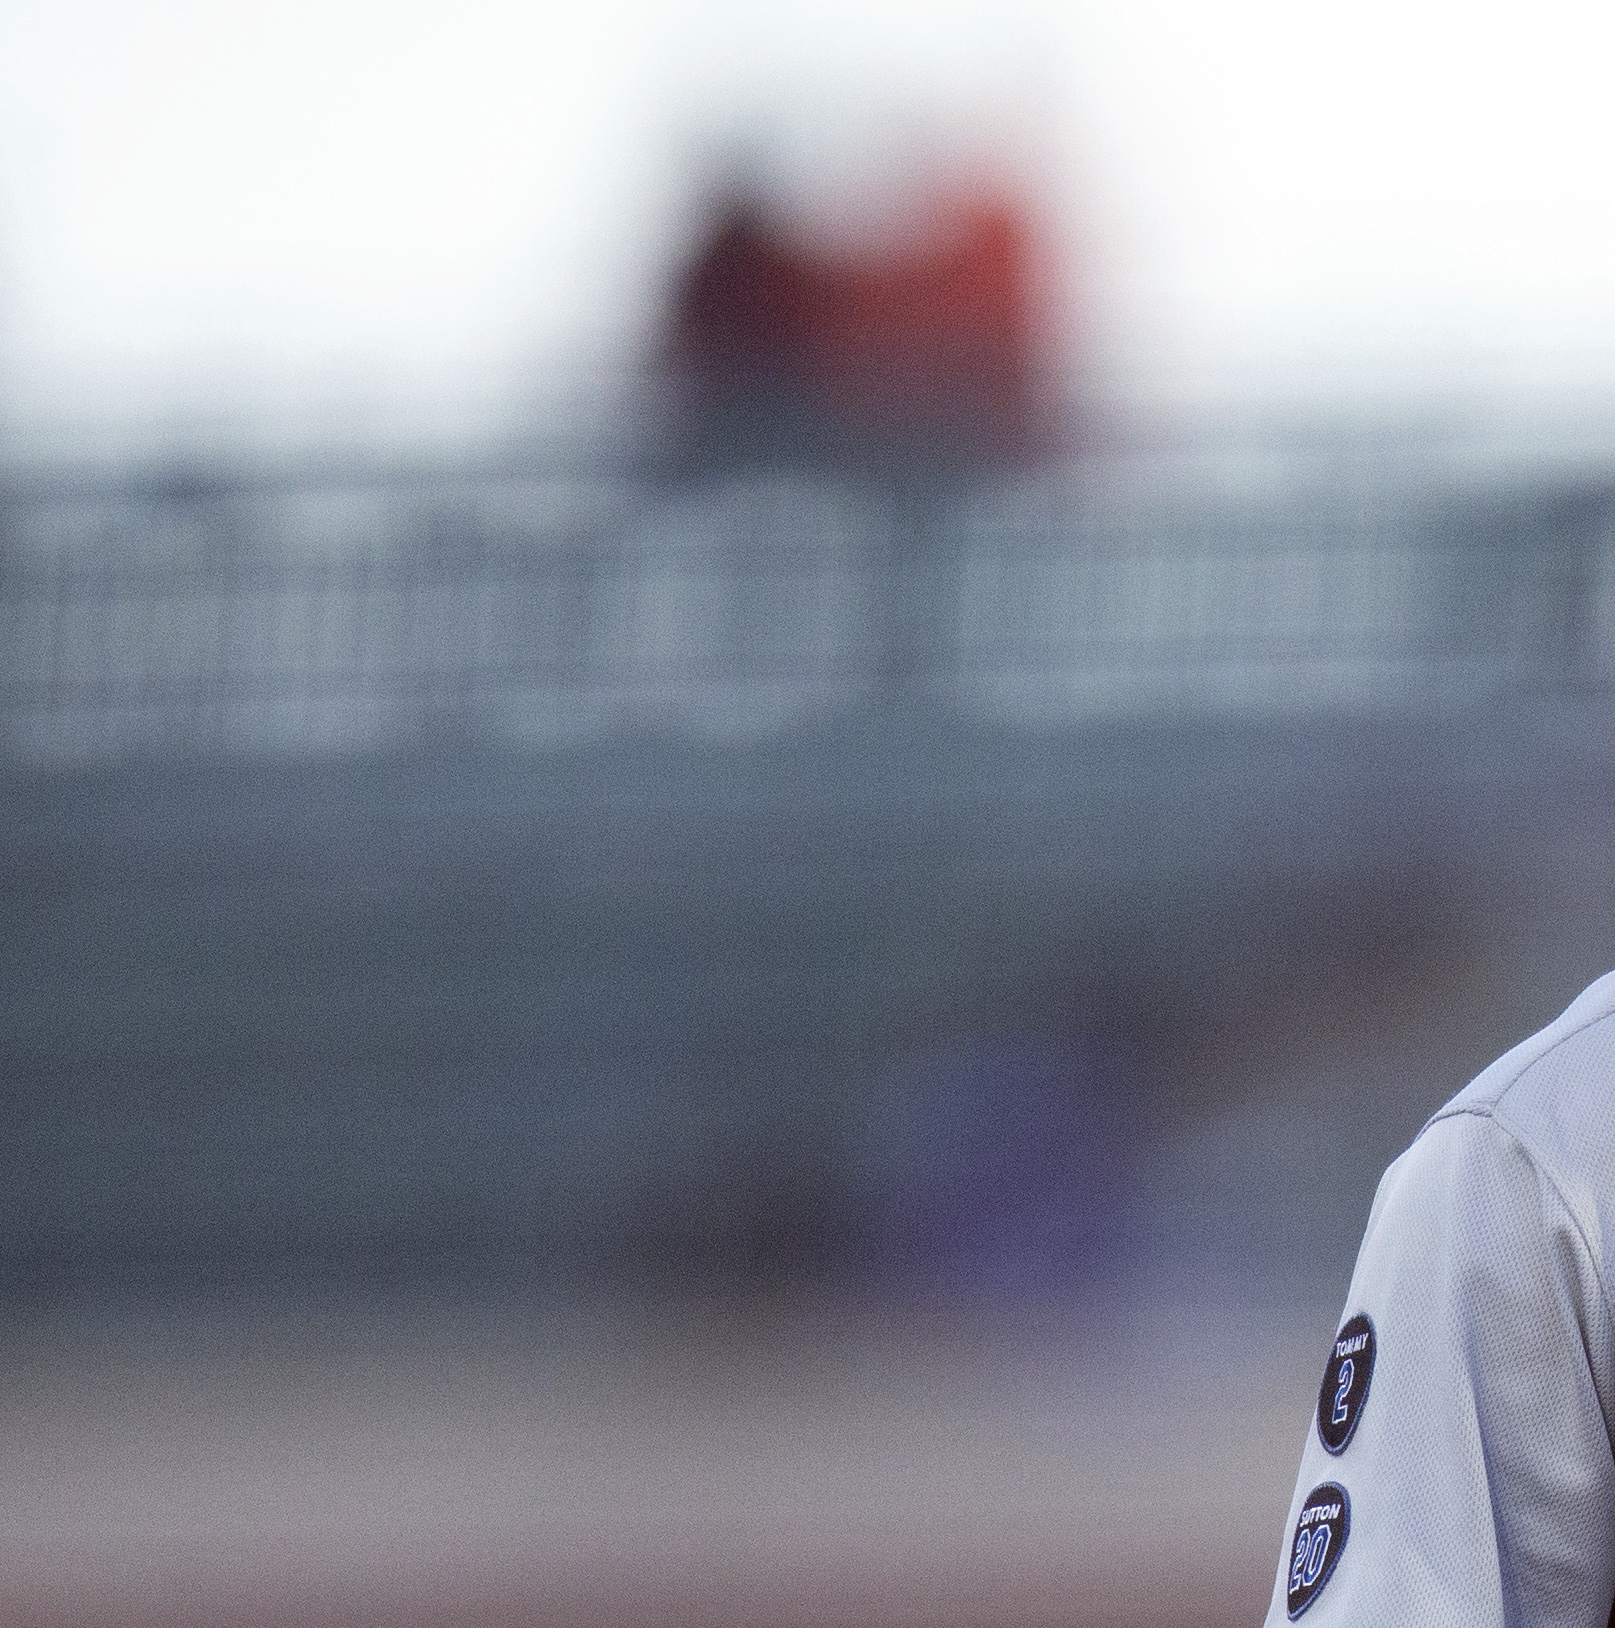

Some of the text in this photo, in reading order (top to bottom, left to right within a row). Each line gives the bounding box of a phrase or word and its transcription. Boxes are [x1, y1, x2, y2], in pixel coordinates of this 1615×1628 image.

[1335, 1332, 1369, 1359] TOMMY
[1331, 1358, 1355, 1425] 2
[1299, 1503, 1341, 1528] SUTTON
[1289, 1523, 1332, 1595] 20
